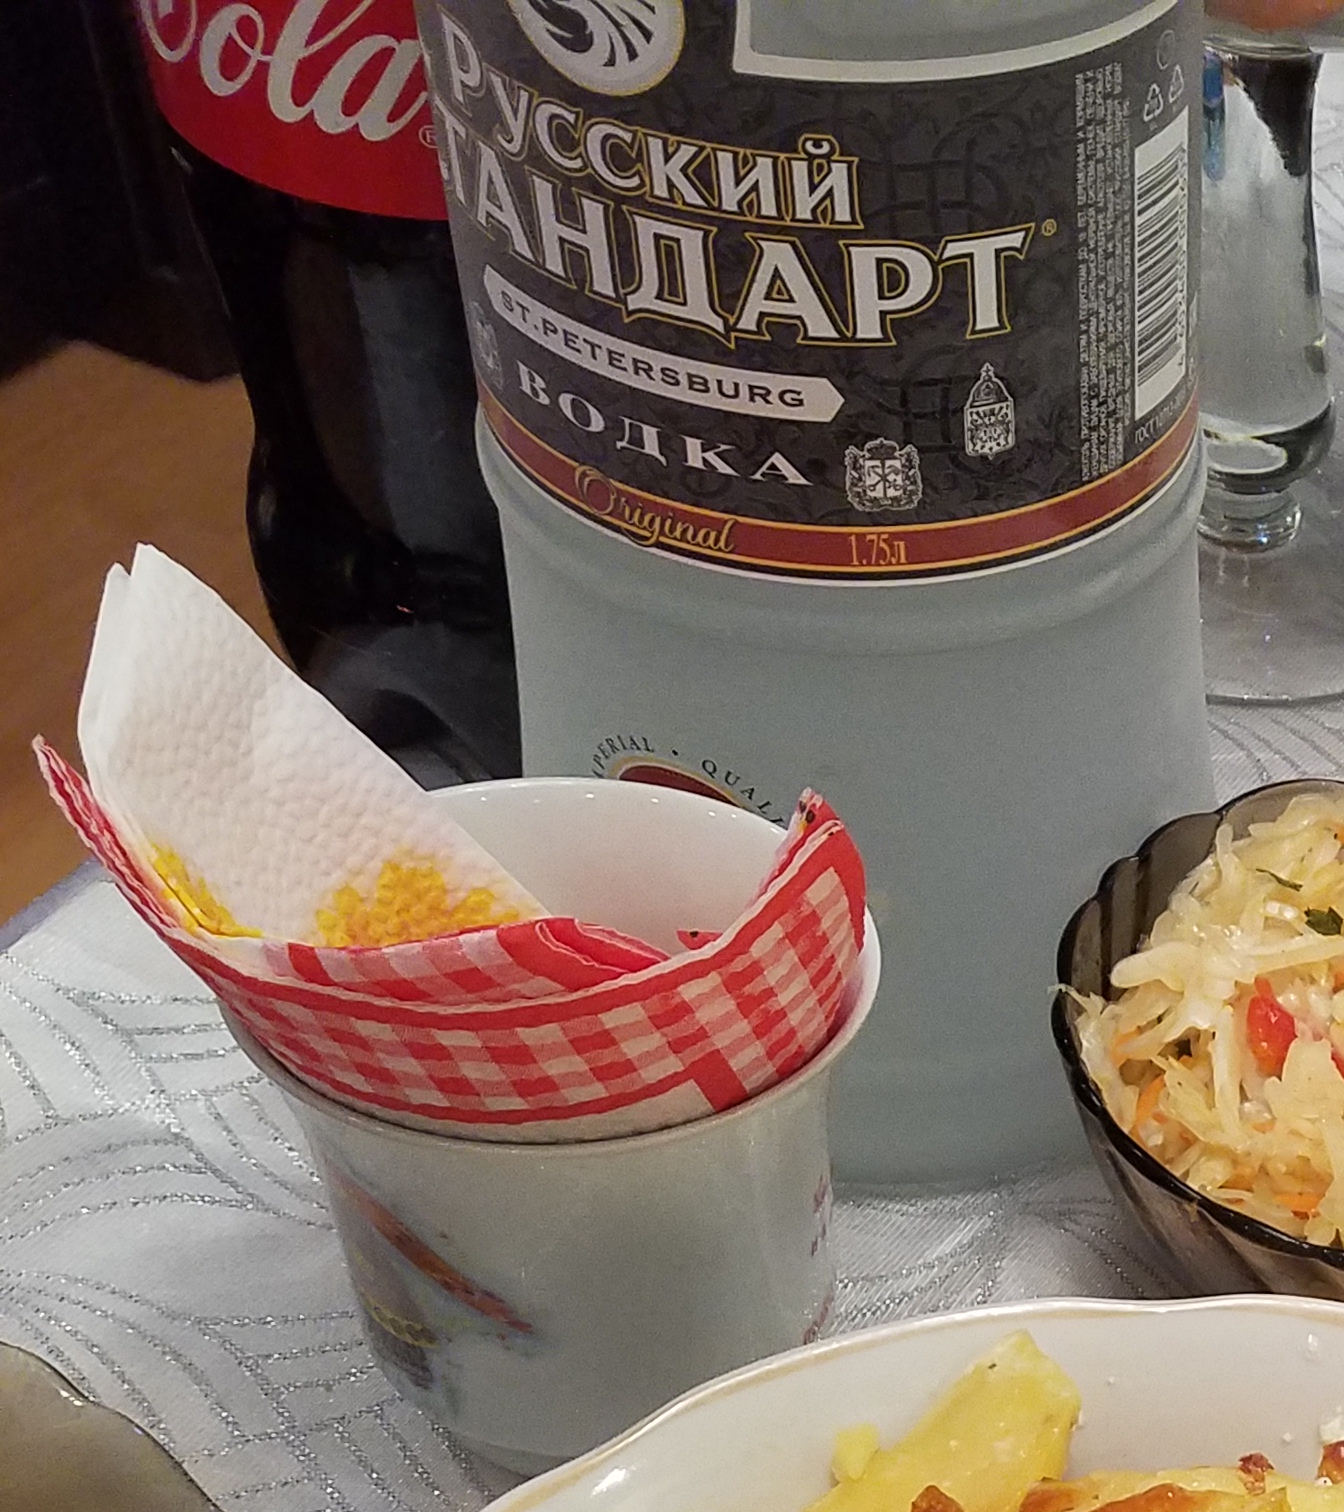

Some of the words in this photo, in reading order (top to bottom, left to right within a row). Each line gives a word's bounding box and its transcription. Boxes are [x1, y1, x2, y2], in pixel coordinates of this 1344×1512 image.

[440, 8, 860, 226] РУССКИЙ
[432, 92, 1034, 346] ТАНДАРТ
[516, 359, 814, 486] ВОДКА
[575, 464, 739, 546] Original
